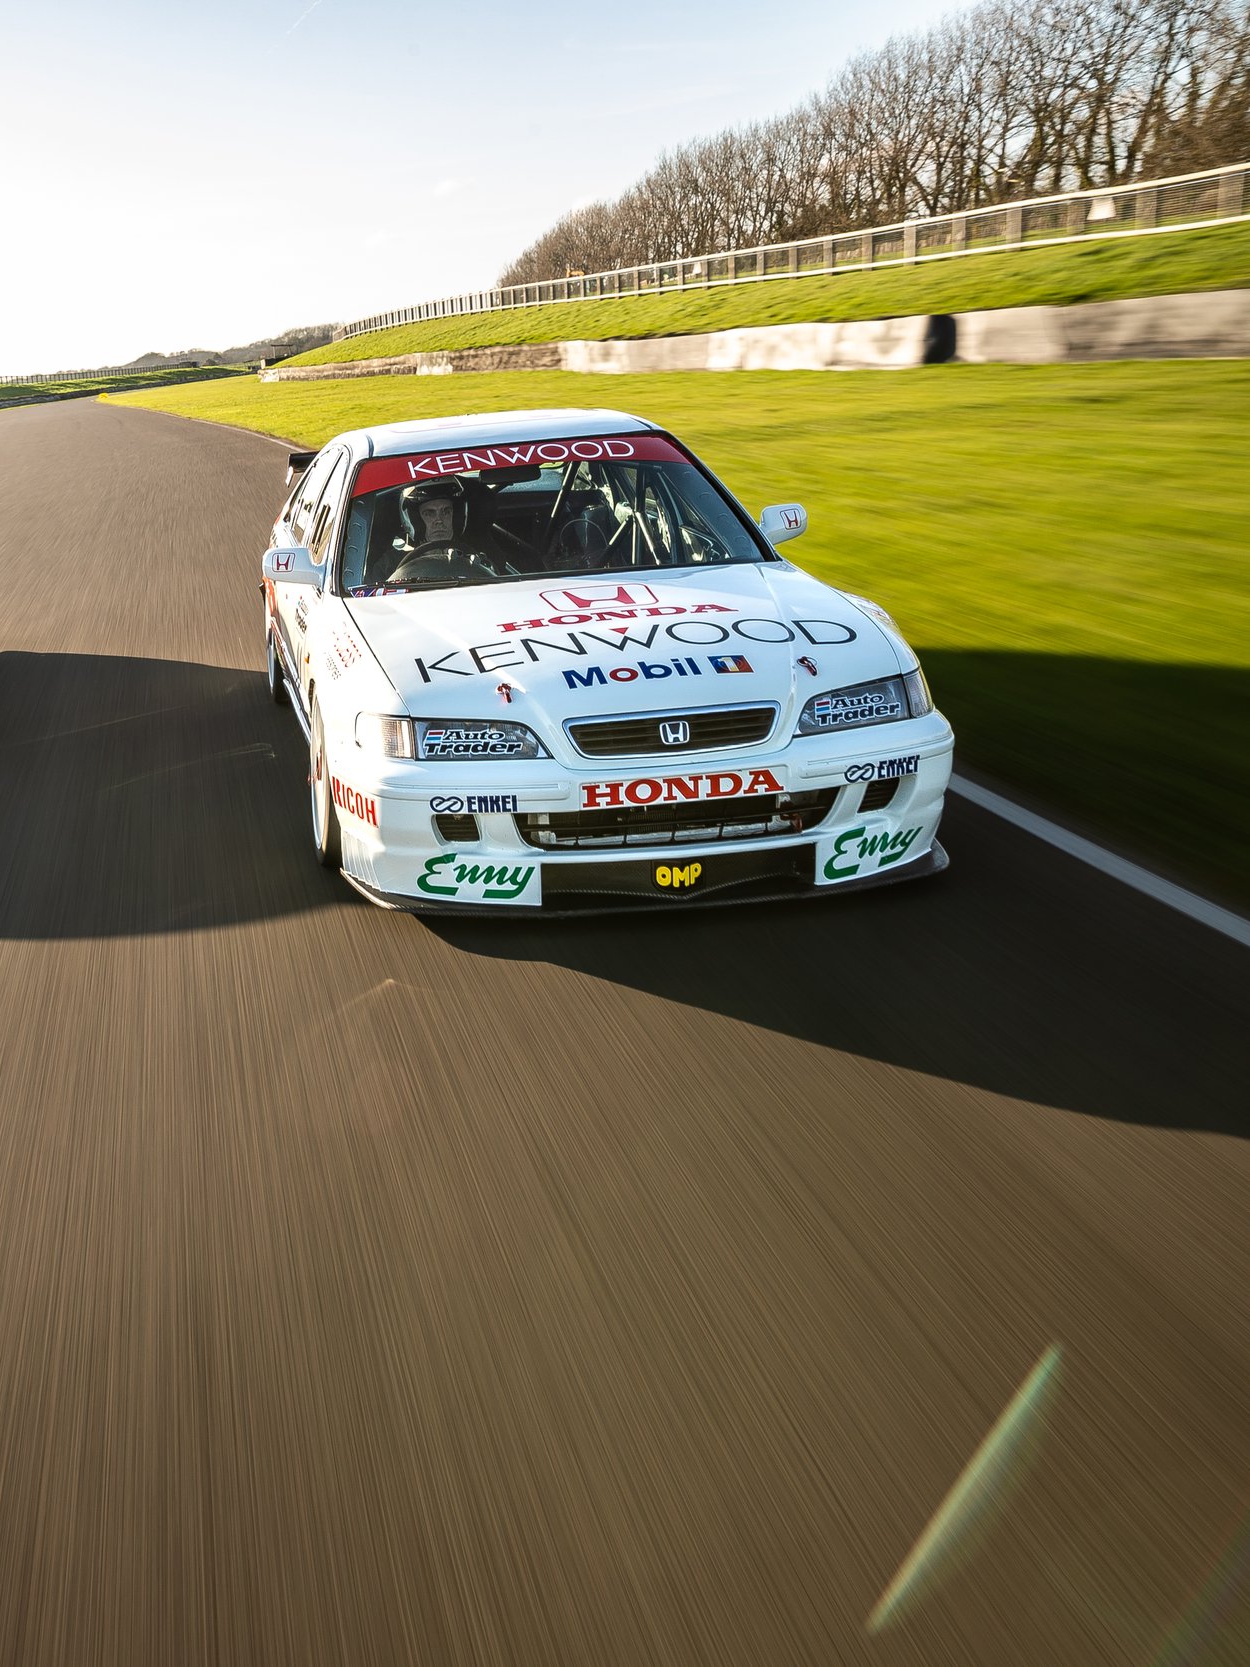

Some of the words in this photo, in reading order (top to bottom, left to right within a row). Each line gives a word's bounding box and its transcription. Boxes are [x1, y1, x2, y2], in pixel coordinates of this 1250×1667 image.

[408, 440, 635, 479] KENWOOD
[496, 603, 740, 633] HONDA
[414, 618, 857, 684] KENWOOD
[561, 657, 702, 689] Mobil
[831, 693, 884, 709] Auto
[815, 703, 899, 726] Trader
[424, 741, 523, 755] Trader
[443, 730, 505, 741] Auto
[878, 755, 921, 780] ENKEI
[332, 775, 379, 828] RICOH
[582, 769, 785, 809] HONDA
[466, 795, 518, 813] ENKEI
[655, 862, 702, 888] OMP
